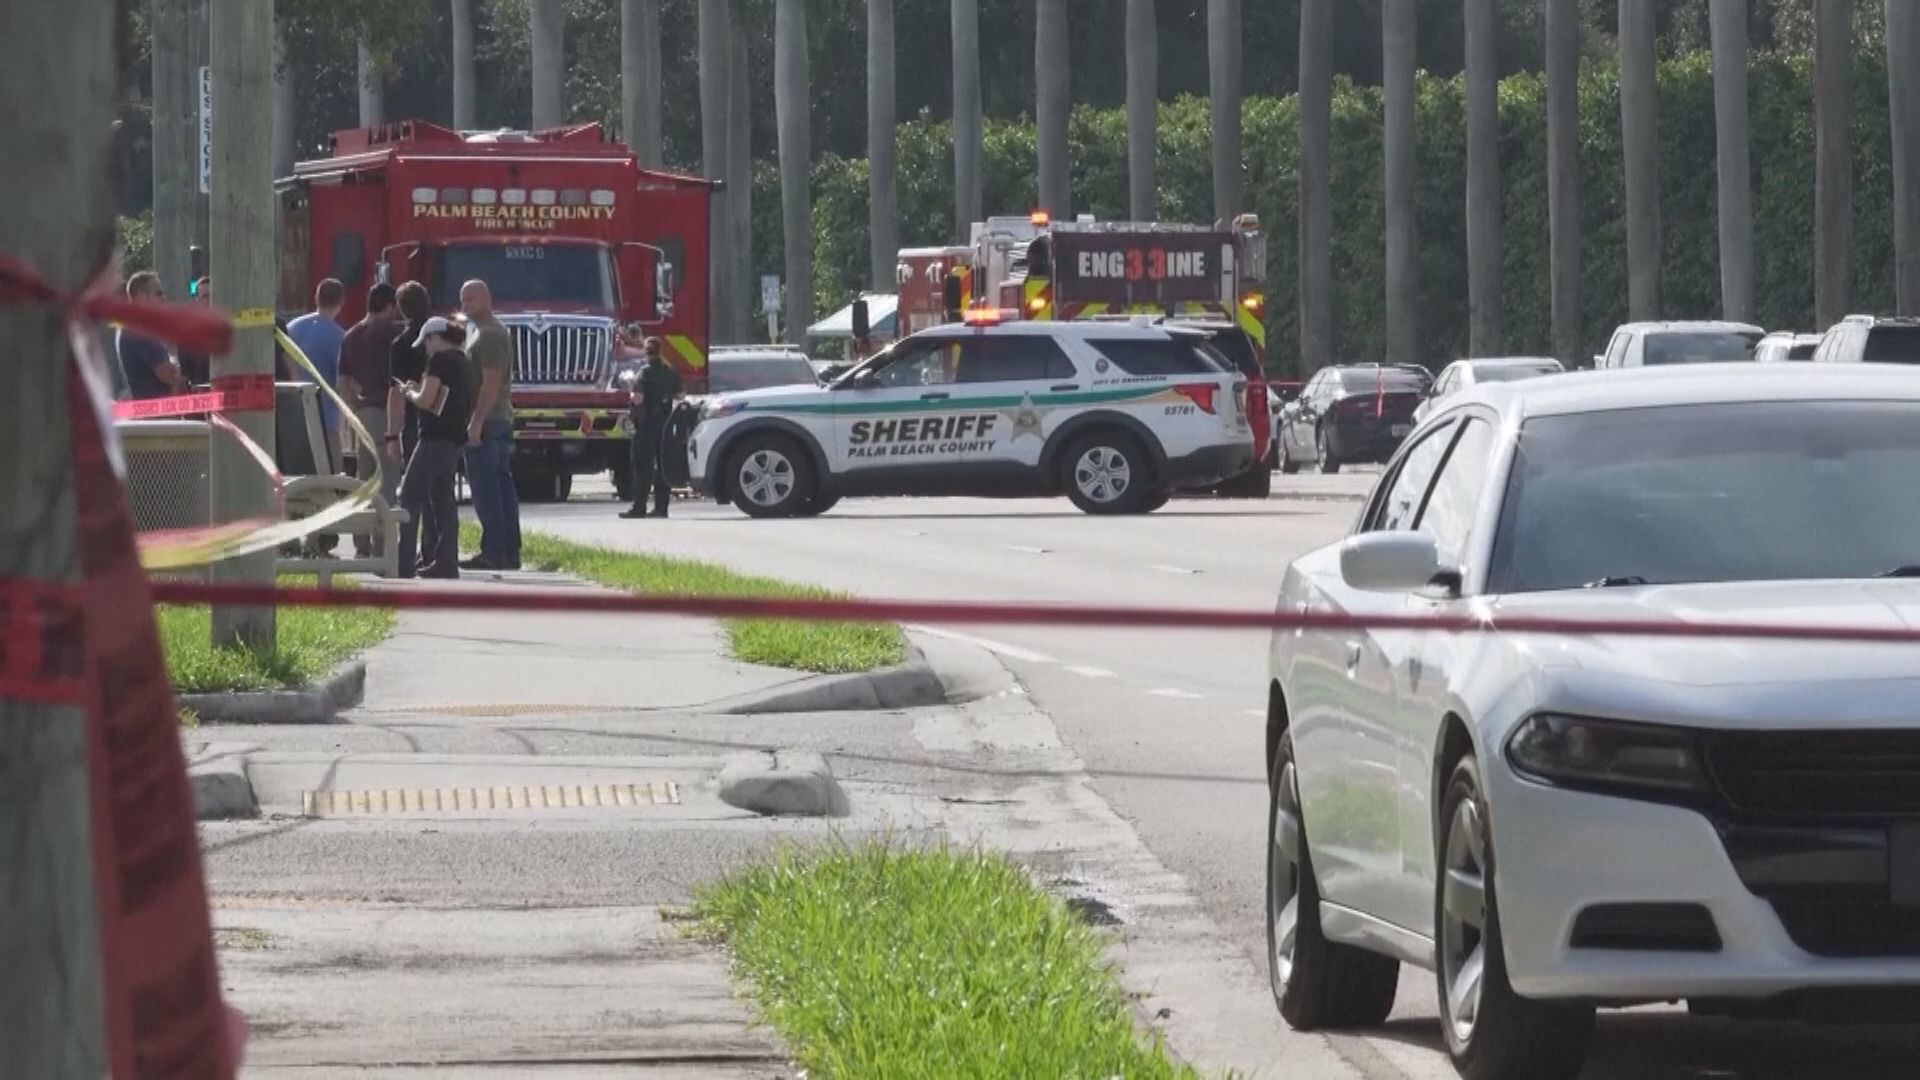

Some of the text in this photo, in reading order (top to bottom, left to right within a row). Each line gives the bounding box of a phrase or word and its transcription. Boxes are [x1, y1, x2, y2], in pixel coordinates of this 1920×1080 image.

[413, 204, 616, 219] PALM BEACH COUNTY
[475, 218, 501, 228] FIRE
[849, 414, 998, 445] SHERIFF
[848, 440, 996, 458] PALM BEACH COUNTY
